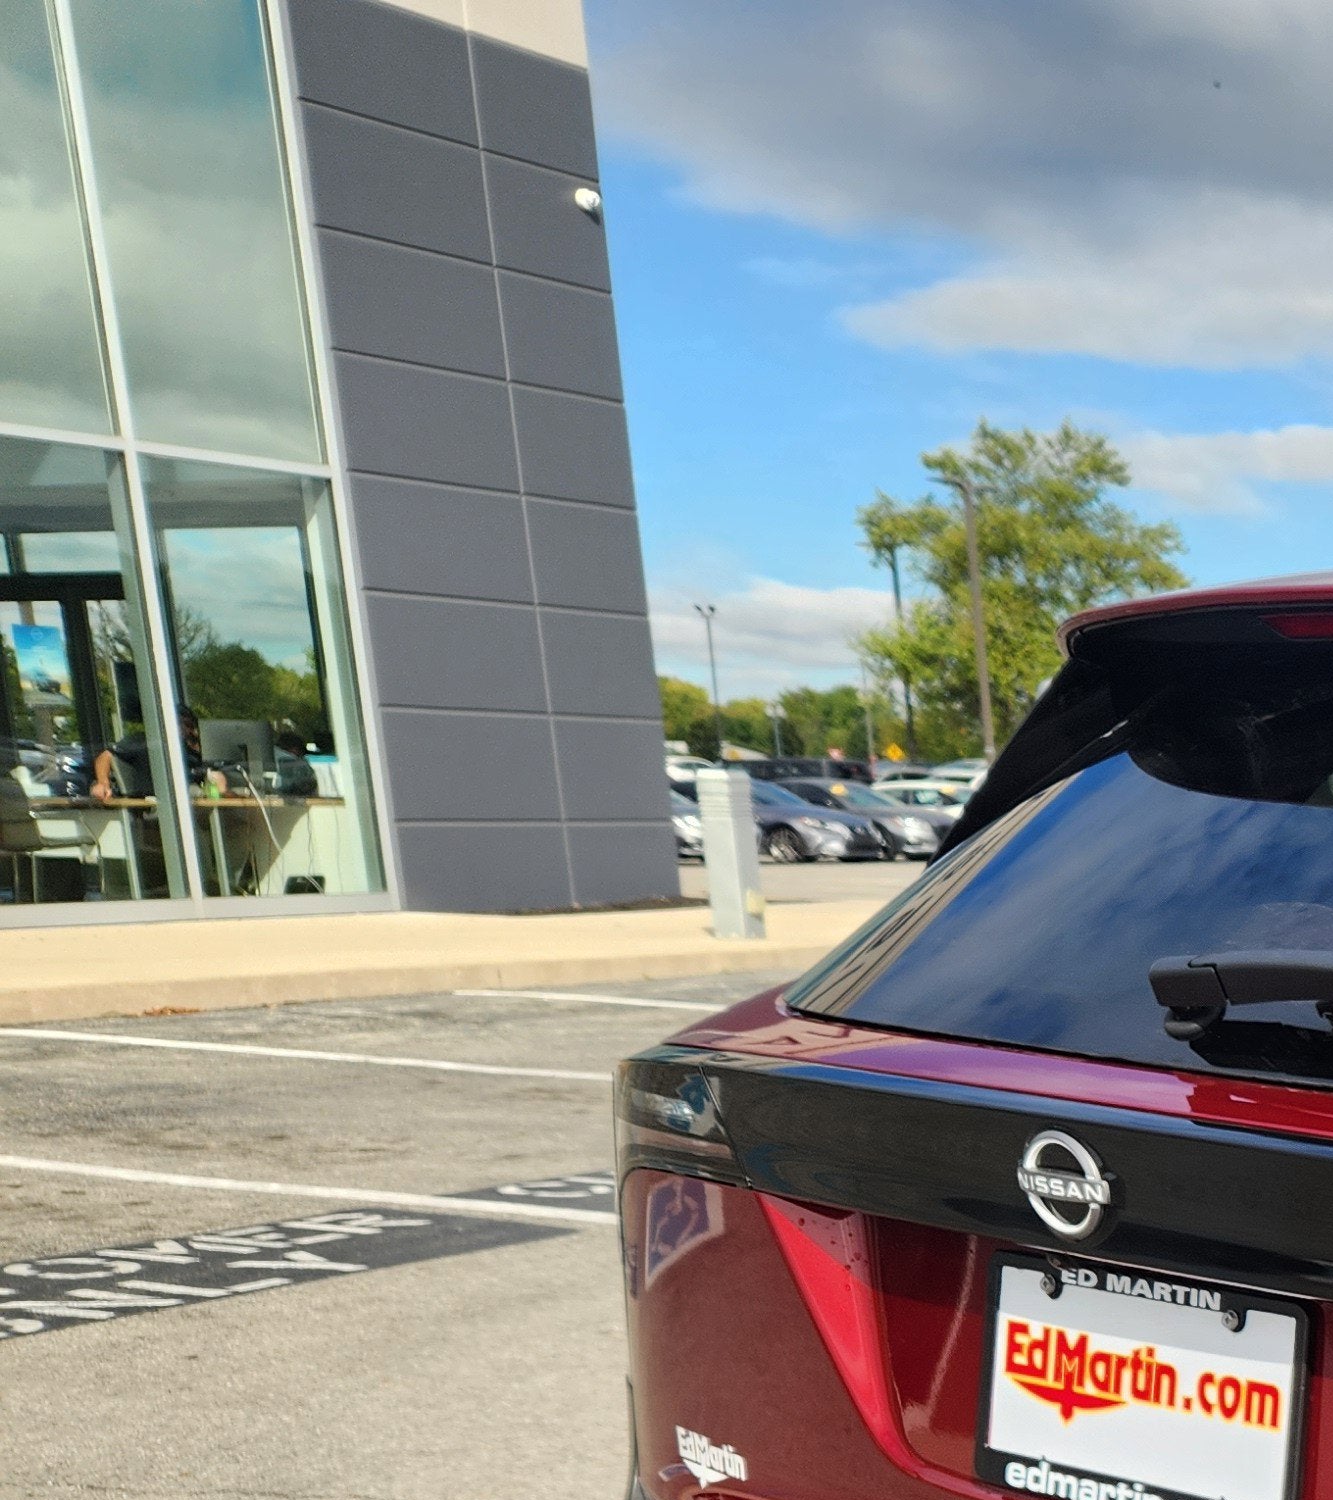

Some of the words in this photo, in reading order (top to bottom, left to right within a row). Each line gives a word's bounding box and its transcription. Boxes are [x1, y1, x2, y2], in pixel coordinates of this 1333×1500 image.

[1017, 1171, 1105, 1204] NISSAN
[1060, 1268, 1099, 1289] ED
[1105, 1273, 1222, 1312] MARTIN
